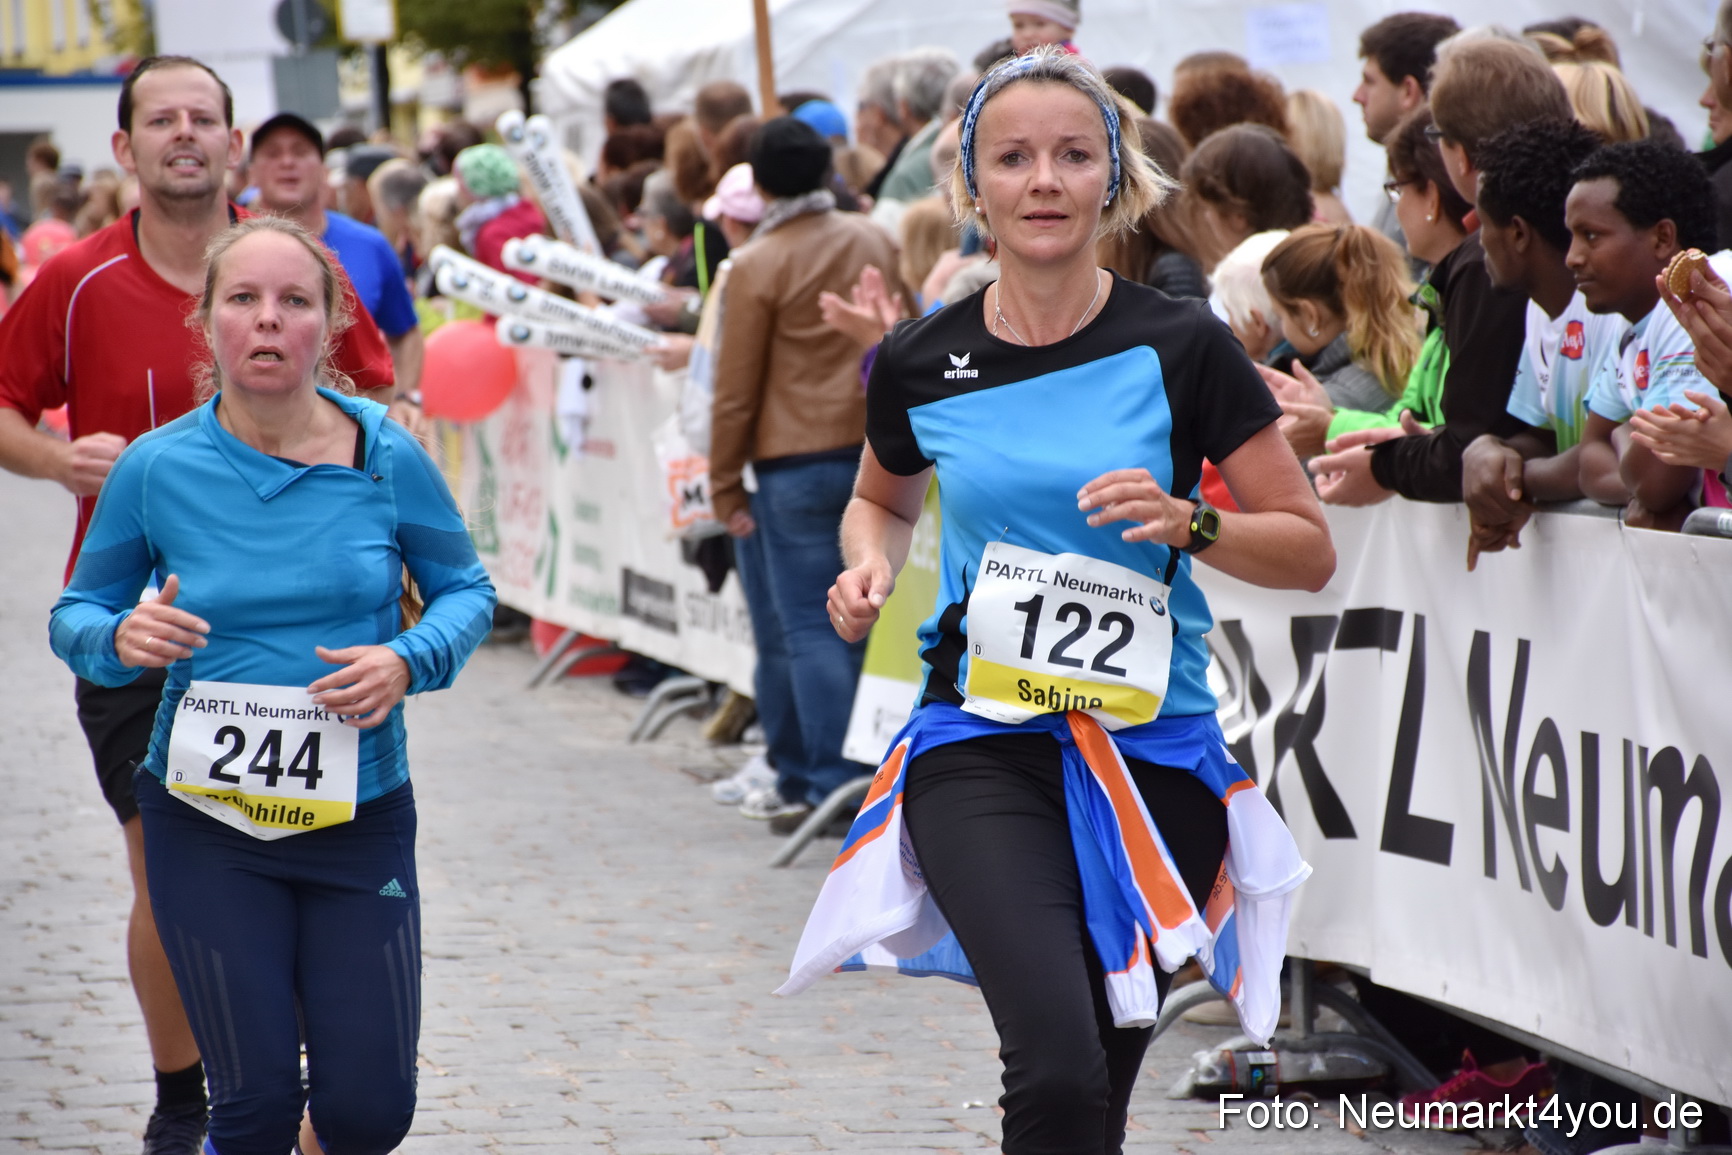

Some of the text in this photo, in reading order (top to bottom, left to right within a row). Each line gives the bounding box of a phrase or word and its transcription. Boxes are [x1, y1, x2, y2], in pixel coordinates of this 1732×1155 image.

[944, 368, 979, 379] erima
[985, 560, 1144, 606] PARTL Neumarkt
[1014, 594, 1135, 677] 122
[183, 697, 330, 721] PARTL Neumarkt
[1017, 679, 1103, 711] Sabine
[208, 725, 323, 790] 244
[175, 772, 183, 782] D
[379, 889, 407, 898] adidas
